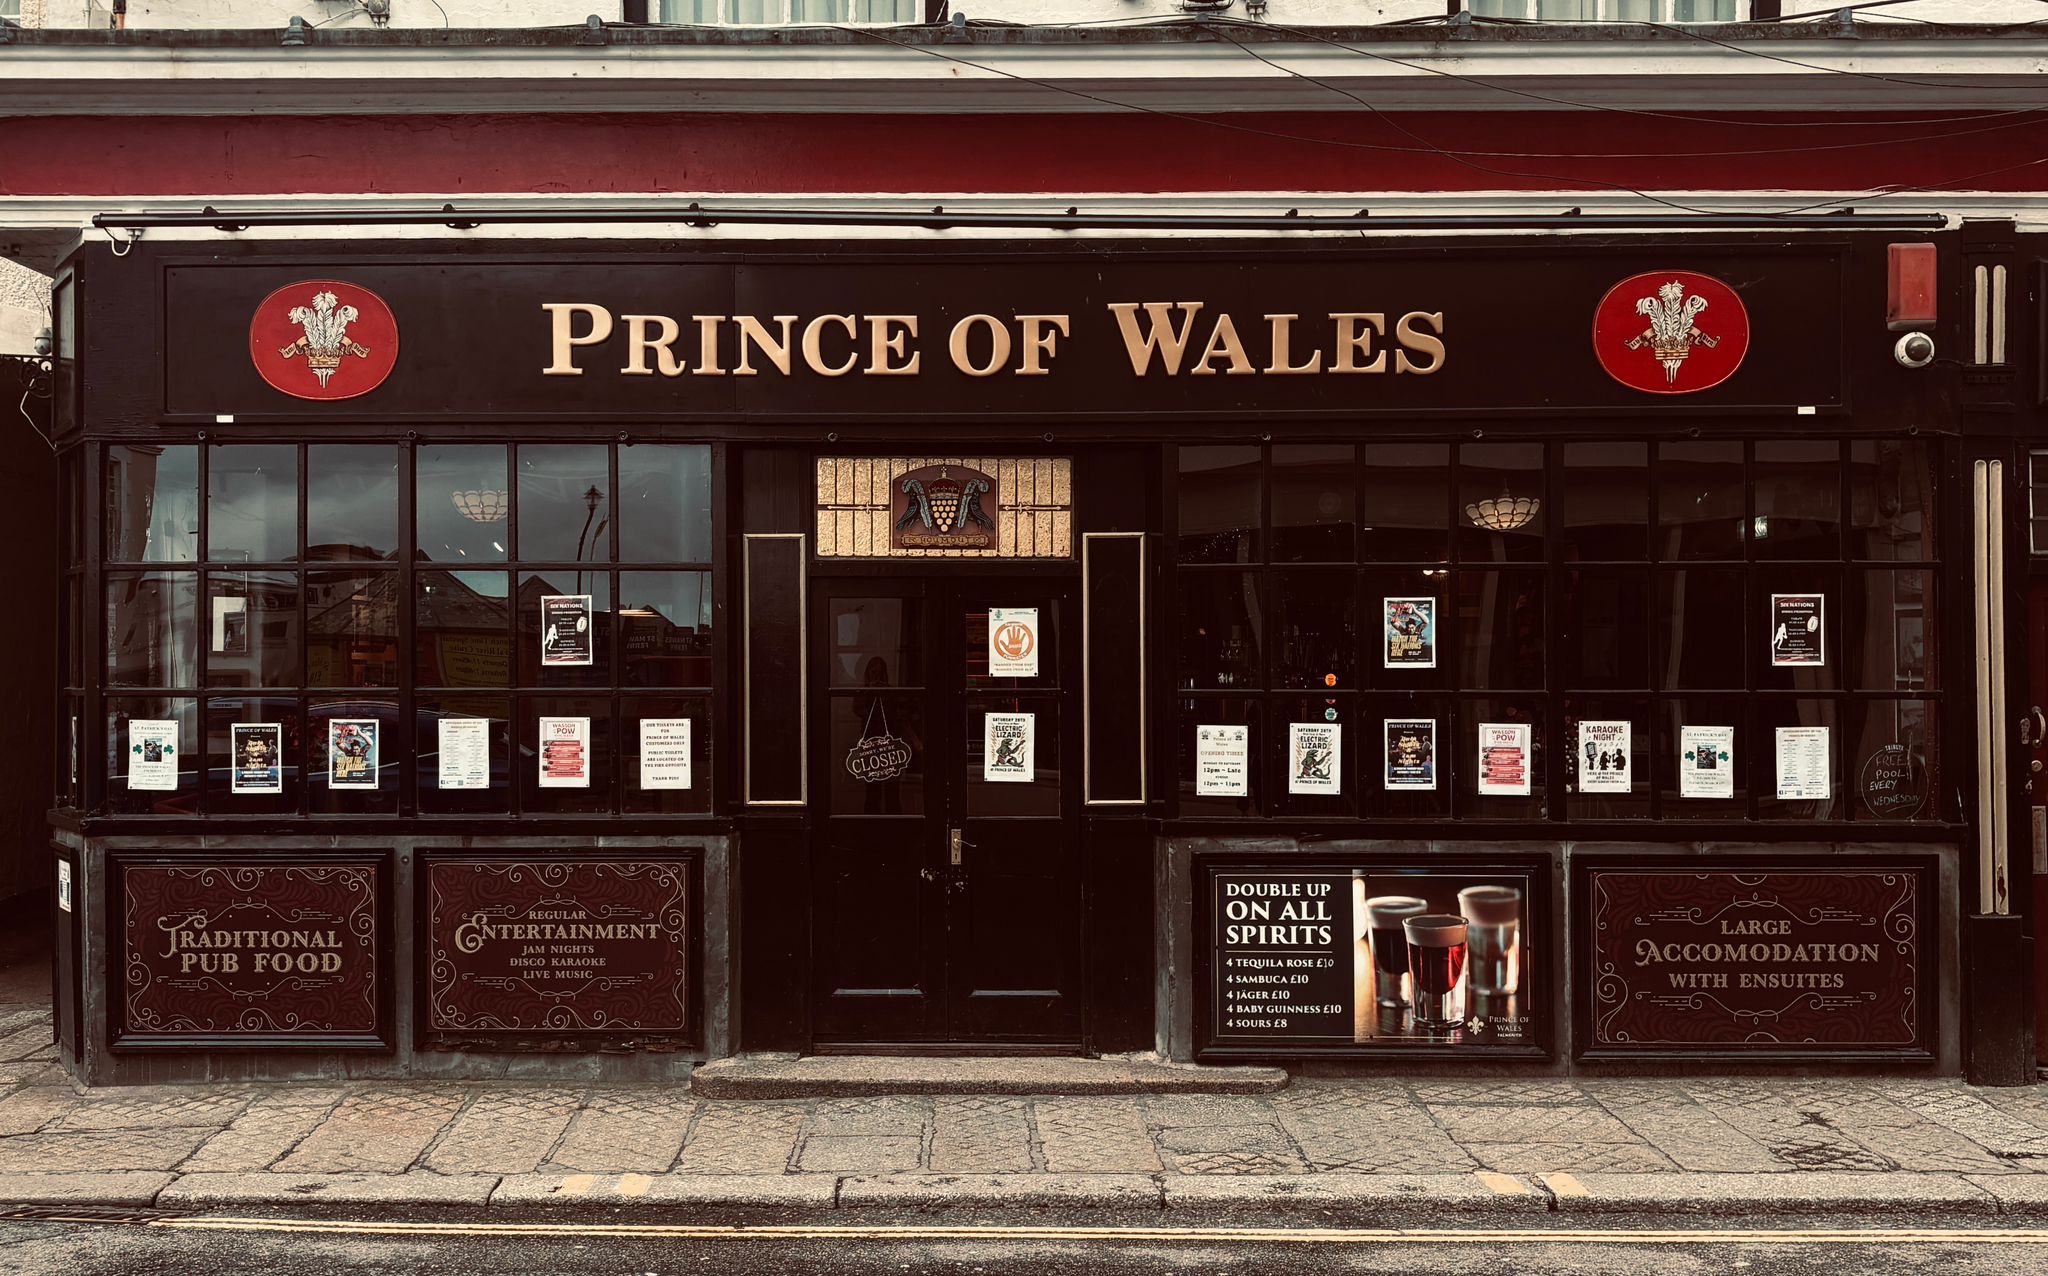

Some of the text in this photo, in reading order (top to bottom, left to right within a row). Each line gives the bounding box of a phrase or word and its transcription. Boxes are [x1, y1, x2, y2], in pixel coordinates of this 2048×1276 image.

[542, 301, 1446, 377] PRINCE OF WALES
[556, 727, 576, 735] POW
[1585, 725, 1624, 734] KARAOKE
[1593, 733, 1616, 741] NIGHT
[1301, 742, 1328, 750] LIZARD
[852, 749, 907, 774] CLOSED
[1876, 753, 1906, 767] FREE
[1869, 779, 1898, 791] EVERY
[1873, 793, 1921, 806] WEDNESDAY
[1226, 883, 1331, 897] DOUBLE UP
[529, 910, 587, 920] REGULAR
[1226, 900, 1332, 921] ON ALL
[454, 913, 661, 954] ENTERTAINMENT
[1720, 919, 1792, 936] LARGE
[157, 914, 343, 959] TRADITIONAL
[1226, 925, 1332, 945] SPIRITS
[522, 944, 595, 955] JAM NIGHTS
[1634, 938, 1880, 967] ACCOMODATION
[180, 952, 343, 974] PUB FOOD
[509, 957, 607, 967] DISCO KARAOKE
[1226, 958, 1334, 969] 4 TEQUILA ROSE £10
[523, 970, 593, 979] LIVE MUSIC
[1226, 974, 1309, 984] 4 SAMBUCA £10
[1668, 973, 1845, 989] WITH ENSUITES
[1226, 989, 1291, 1001] 4 JÄGER £10
[1226, 1004, 1342, 1014] 4 BABY GUINNESS £10
[1226, 1019, 1288, 1028] 4 SOURS £8
[1489, 1015, 1517, 1023] PRINCE
[1496, 1024, 1522, 1032] WALES
